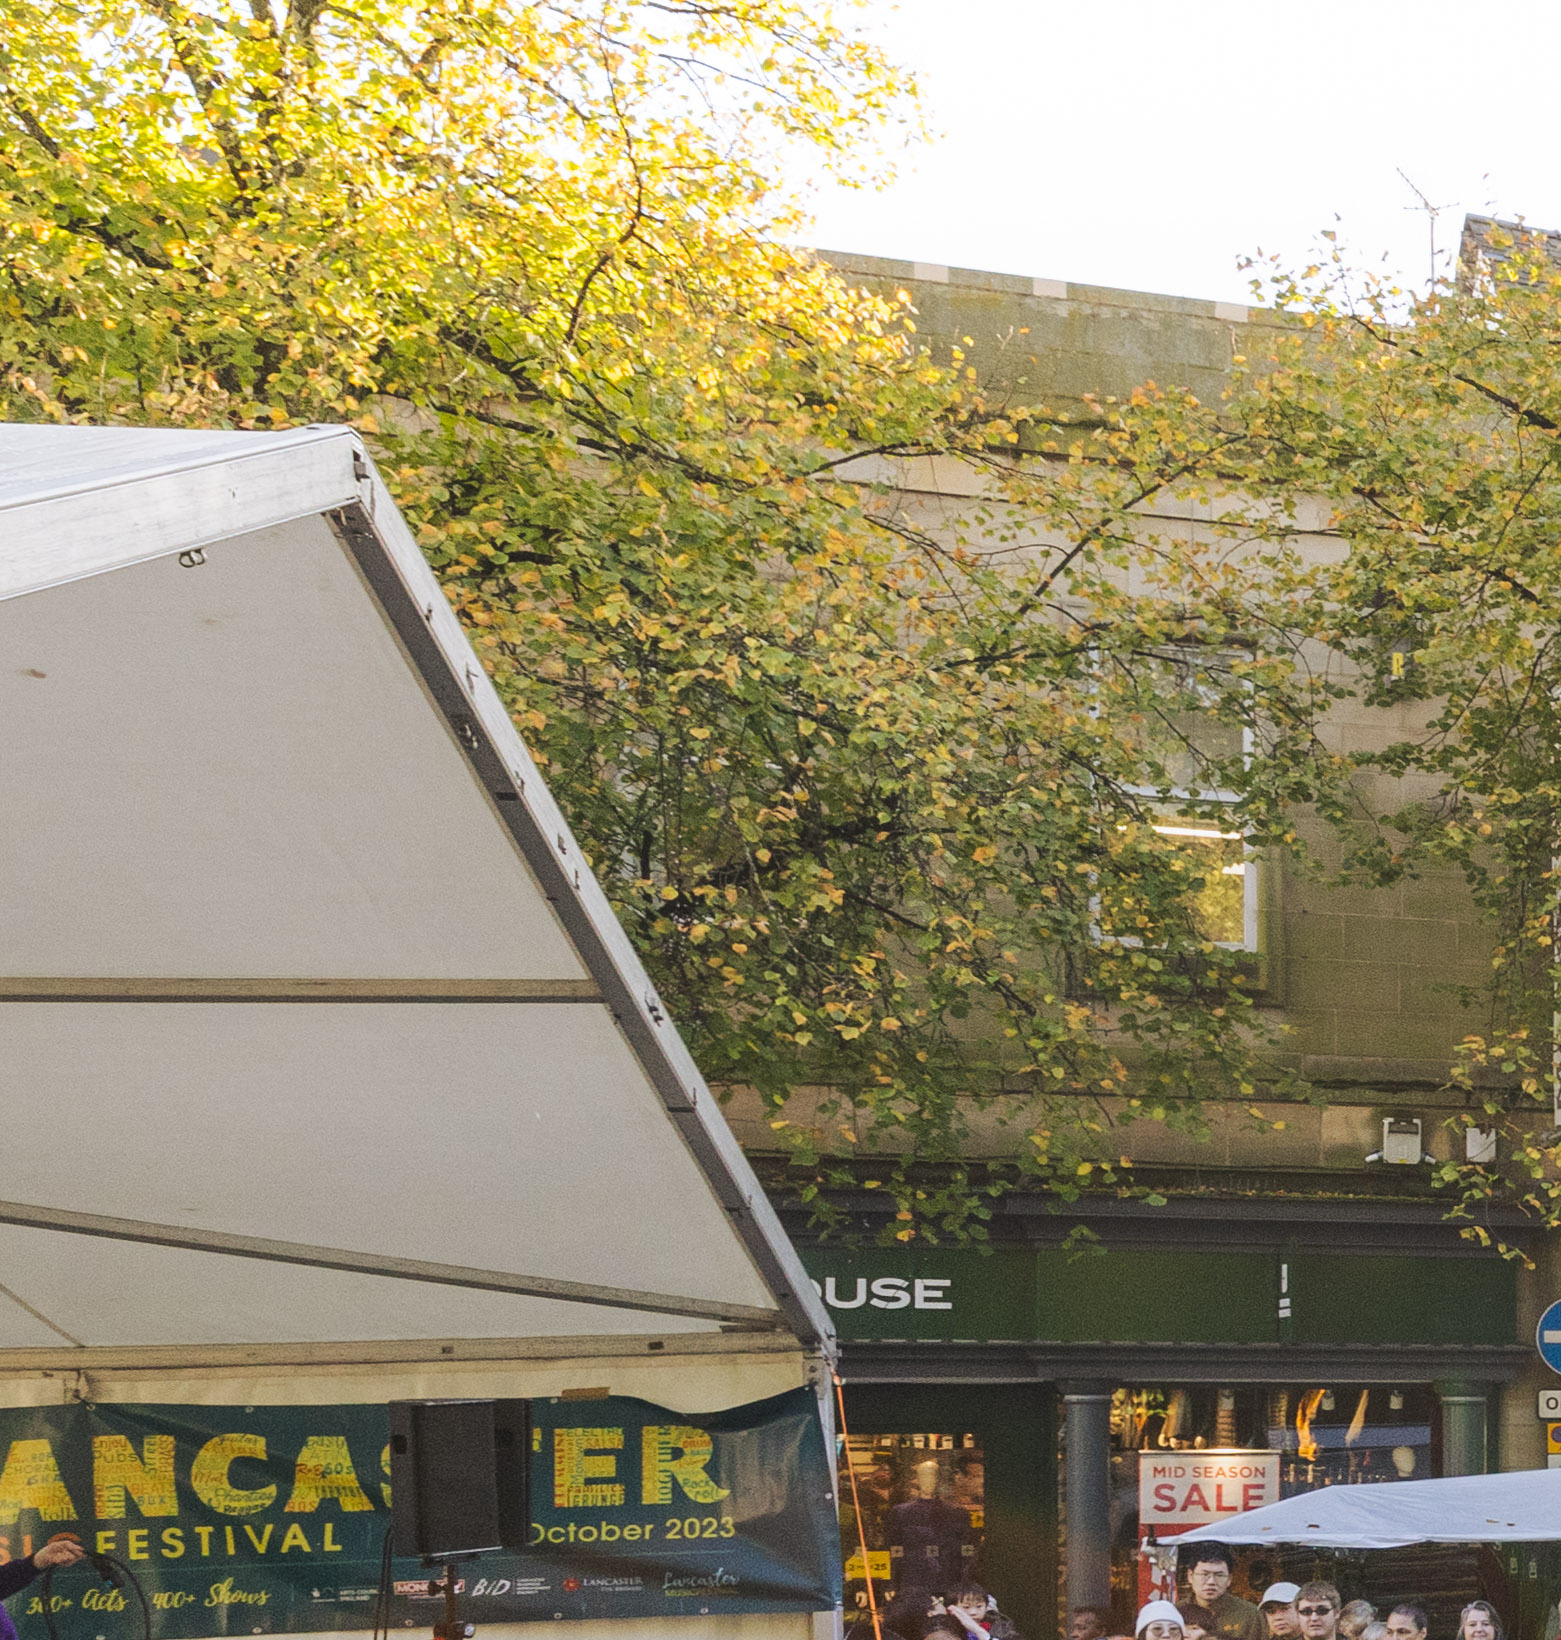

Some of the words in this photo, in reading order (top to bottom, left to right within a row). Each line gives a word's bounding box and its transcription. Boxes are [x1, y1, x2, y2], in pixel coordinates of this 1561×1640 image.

[1152, 1466, 1187, 1478] MID
[1192, 1466, 1266, 1479] SEASON
[1152, 1483, 1266, 1512] SALE
[665, 1516, 737, 1540] 2023
[96, 1523, 343, 1561] FESTIVAL
[152, 1590, 196, 1609] 400+
[204, 1577, 271, 1608] Shows
[583, 1577, 644, 1586] LANCASTER
[82, 1588, 128, 1612] Acts
